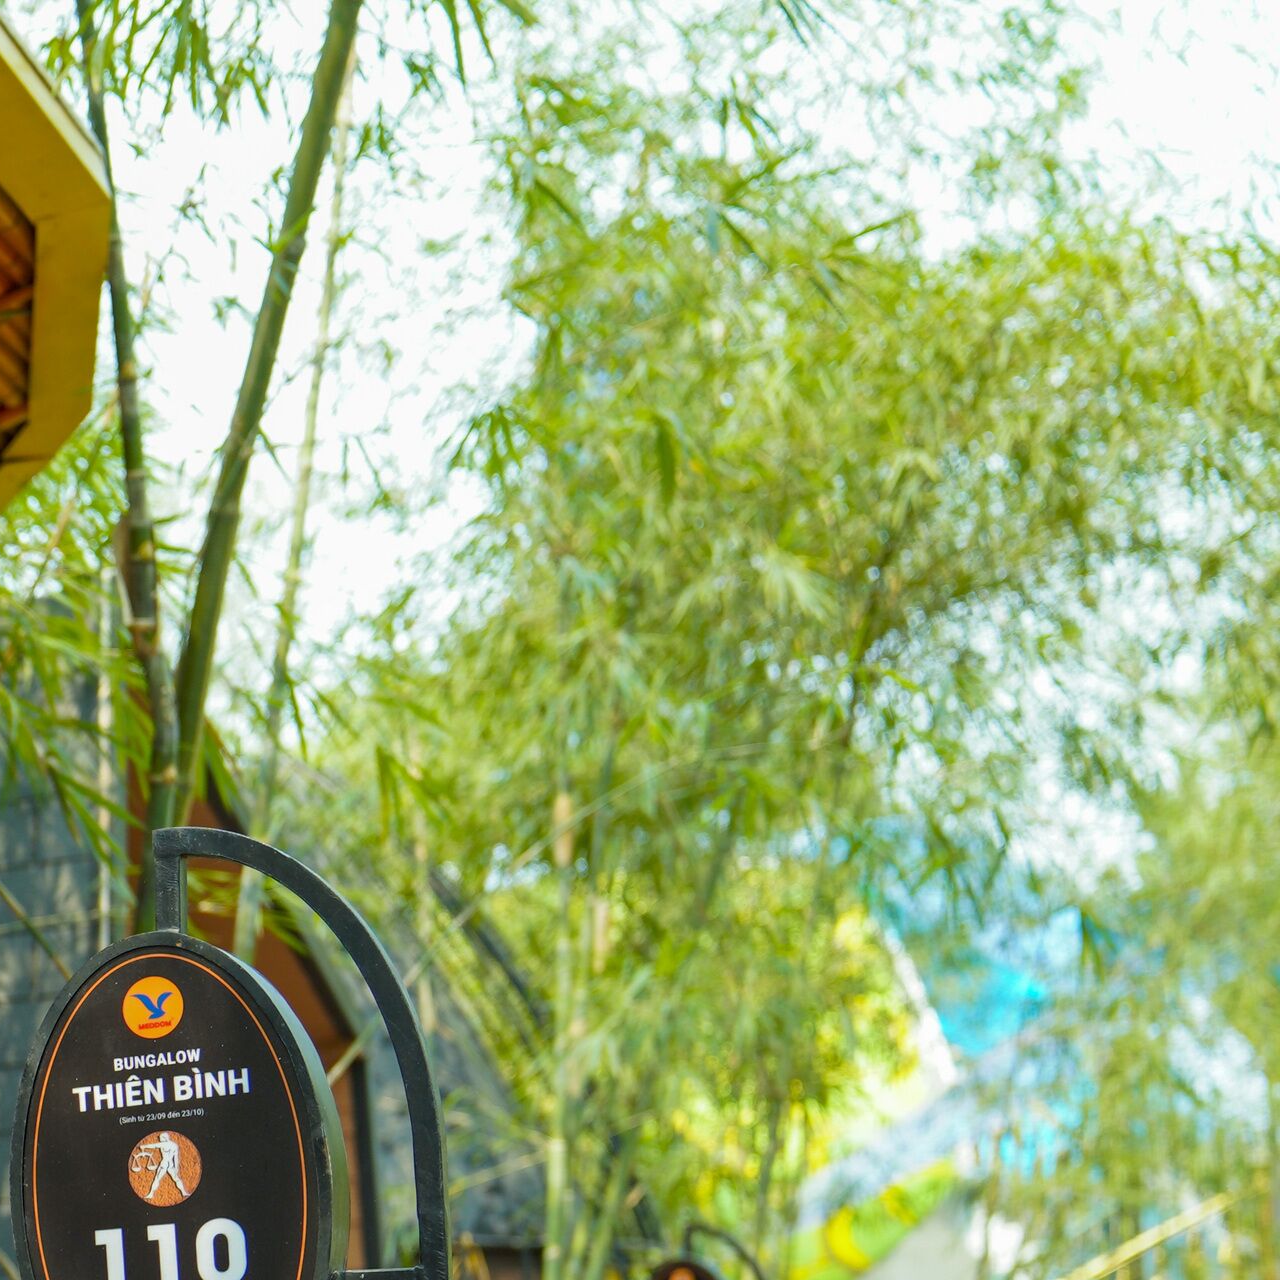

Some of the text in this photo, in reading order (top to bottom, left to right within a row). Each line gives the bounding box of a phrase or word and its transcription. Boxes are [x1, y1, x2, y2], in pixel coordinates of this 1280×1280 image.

[113, 1048, 201, 1072] BUNGALOW
[71, 1067, 250, 1112] THIÊN BÌNH
[146, 1112, 166, 1121] 23/09
[181, 1107, 204, 1117] 23/10)
